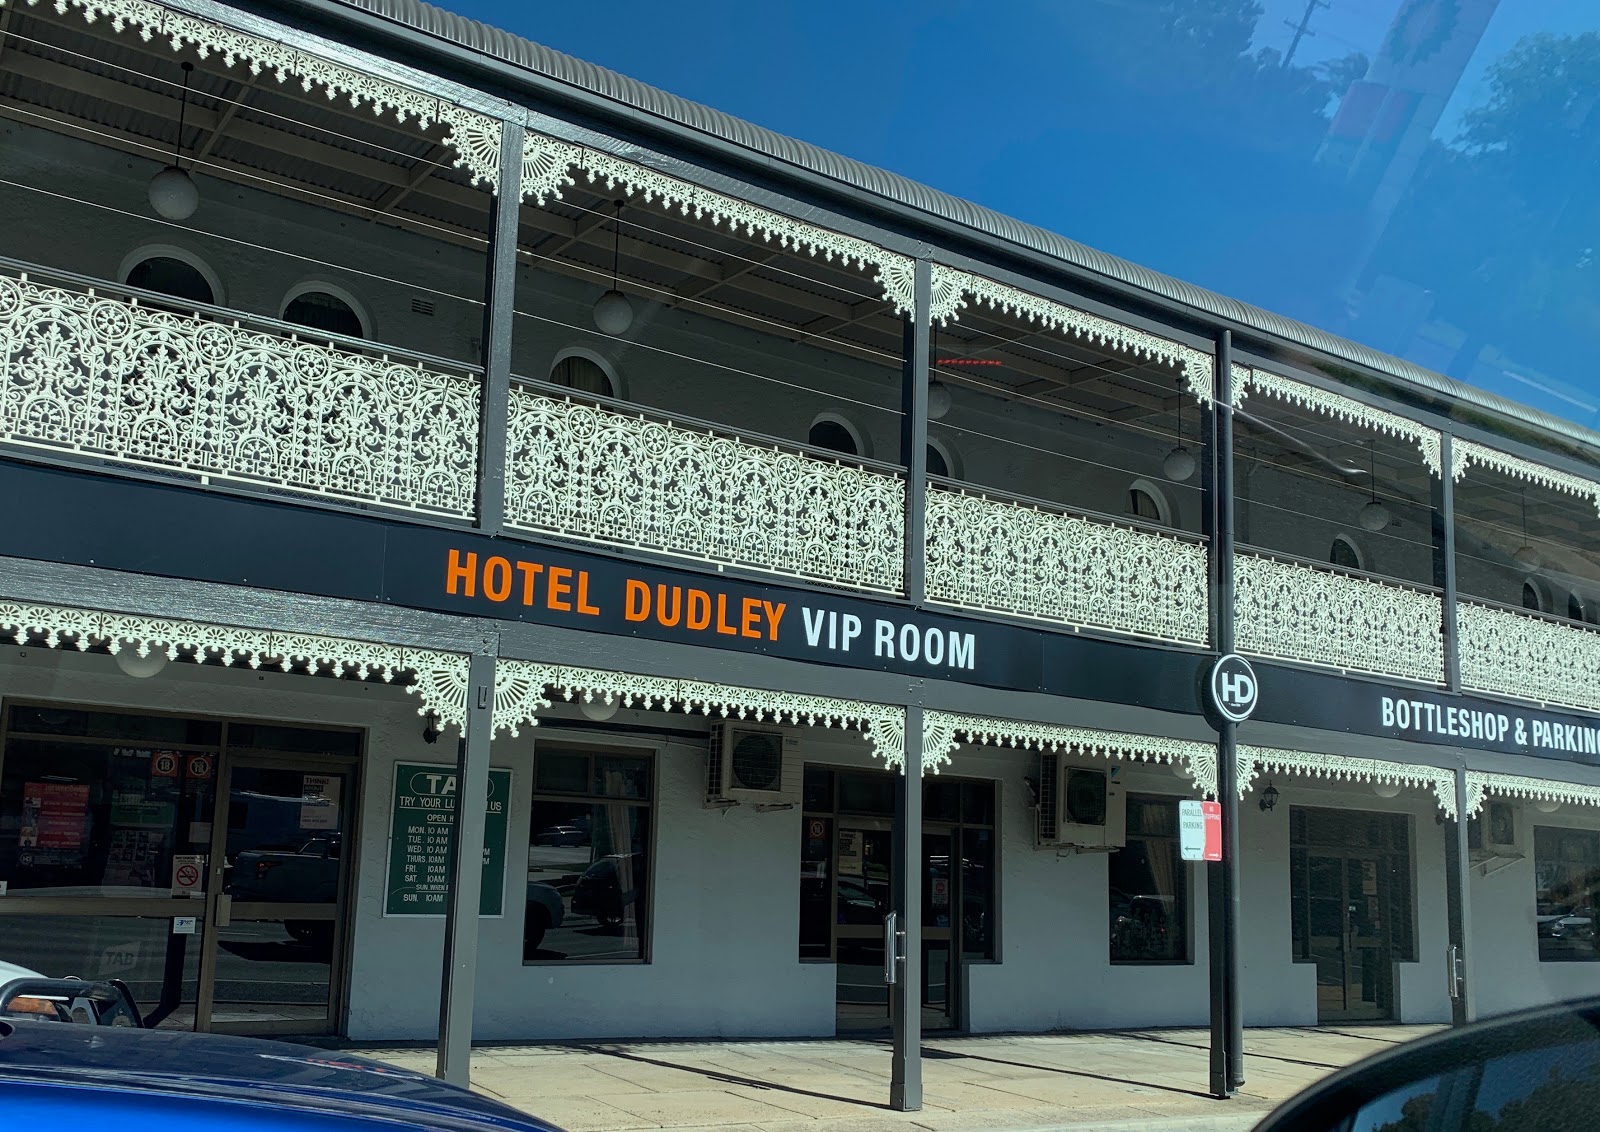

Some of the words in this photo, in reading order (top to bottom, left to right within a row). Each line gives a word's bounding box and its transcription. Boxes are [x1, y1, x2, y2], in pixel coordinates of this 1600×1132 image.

[445, 548, 600, 616] HOTEL
[624, 578, 786, 642] DUDLEY
[801, 606, 863, 652] VIP
[874, 620, 976, 670] ROOM
[1221, 672, 1254, 704] HD
[1381, 696, 1509, 742] BOTTLESHOP
[1514, 717, 1528, 746] &
[426, 774, 457, 795] TA
[400, 795, 416, 807] TRY
[420, 797, 441, 808] YOUR
[445, 798, 455, 809] LU
[490, 801, 502, 812] US
[1181, 808, 1203, 817] PARALLEL
[427, 813, 447, 822] OPEN
[1182, 821, 1203, 829] PARKING
[407, 825, 427, 835] MON.
[427, 826, 436, 835] 10
[436, 827, 449, 835] AM
[408, 835, 425, 844] TUE.
[427, 836, 435, 844] 10
[435, 836, 448, 844] AM
[407, 845, 424, 853] WED.
[426, 845, 434, 853] 10
[434, 846, 447, 854] AM
[407, 854, 428, 863] THURS.
[428, 855, 445, 864] 10AM
[405, 864, 418, 873] FRI.
[427, 865, 446, 873] 10AM
[404, 874, 418, 882] SAT.
[426, 875, 445, 883] 10AM
[403, 893, 419, 902] SUN.
[425, 894, 443, 902] 10AM
